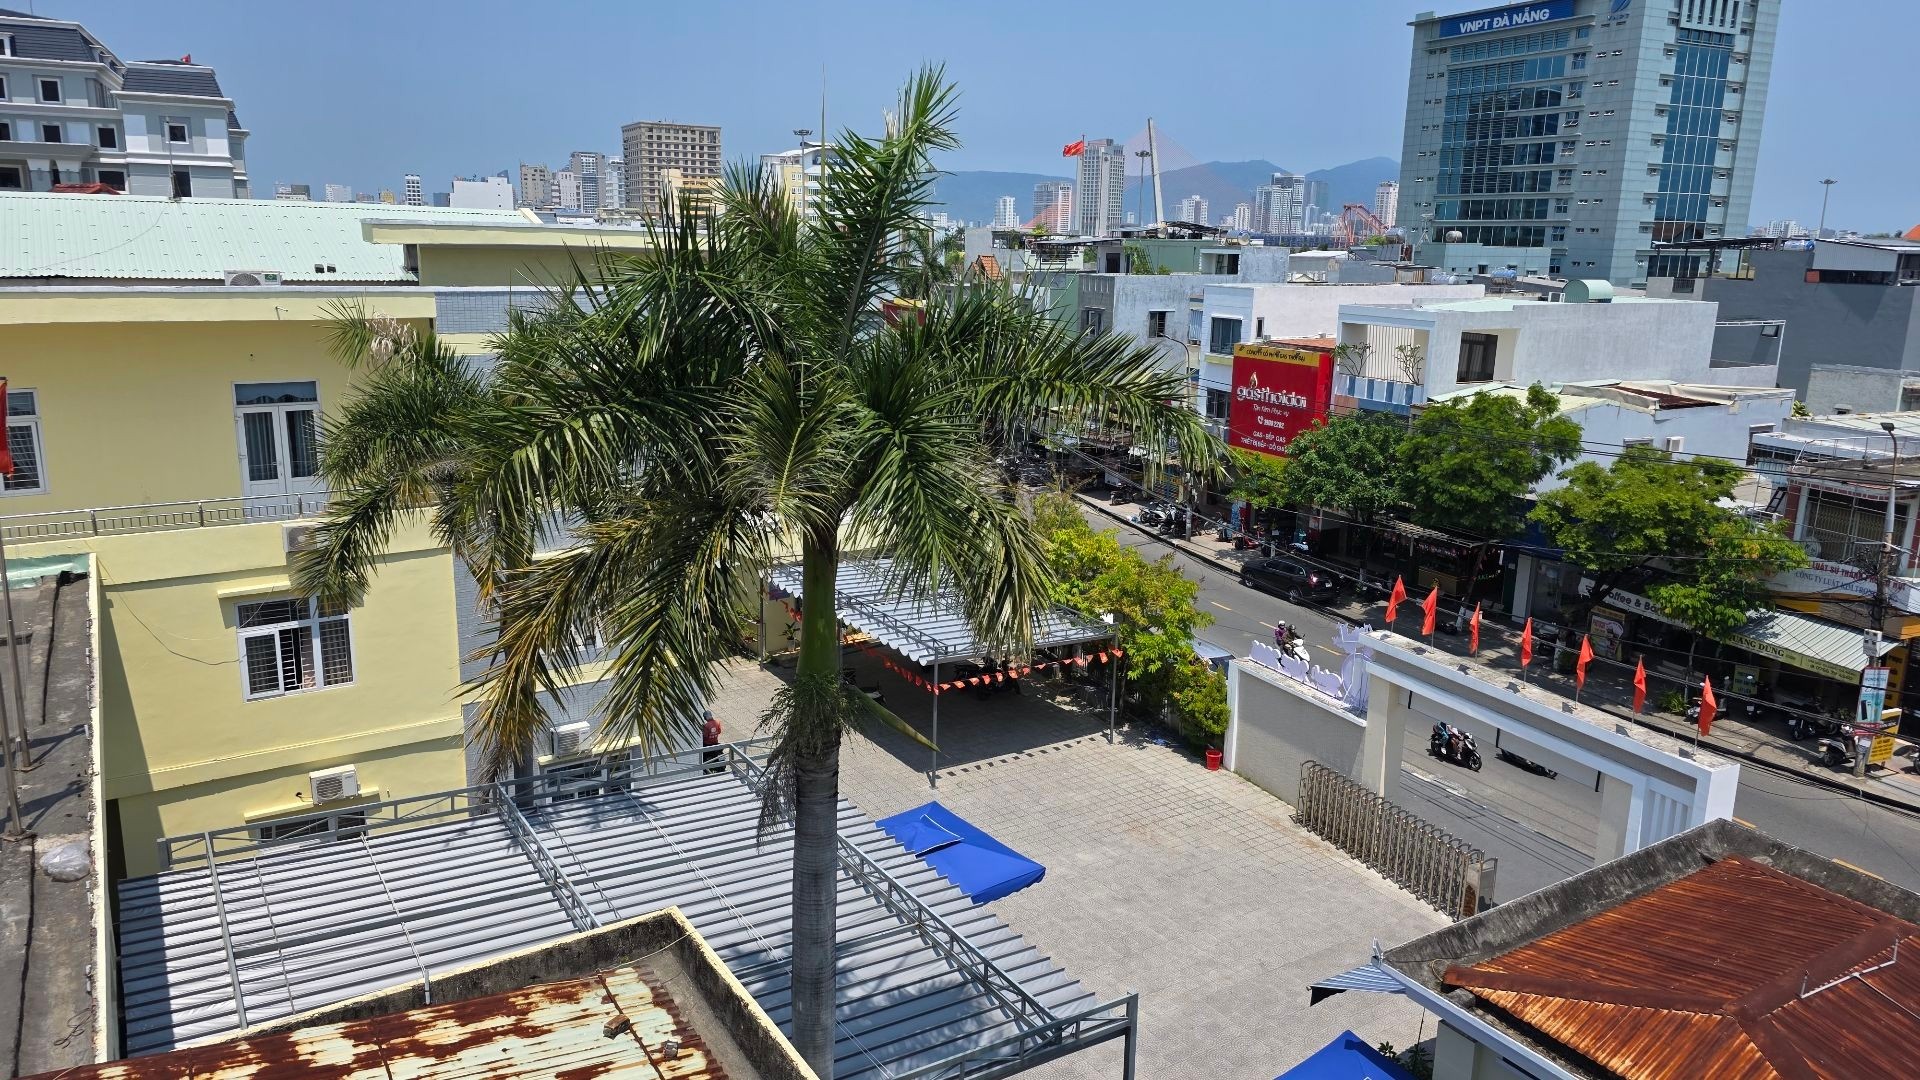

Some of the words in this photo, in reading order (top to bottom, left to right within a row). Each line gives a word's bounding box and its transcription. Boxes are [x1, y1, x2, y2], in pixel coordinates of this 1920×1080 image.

[1459, 18, 1490, 34] VNPT
[1493, 12, 1510, 29] ĐÀ
[1512, 6, 1550, 25] NẴNG
[1275, 435, 1286, 443] GAS
[1795, 570, 1813, 581] CÔNG
[1814, 575, 1823, 584] TY
[1608, 591, 1632, 604] offee
